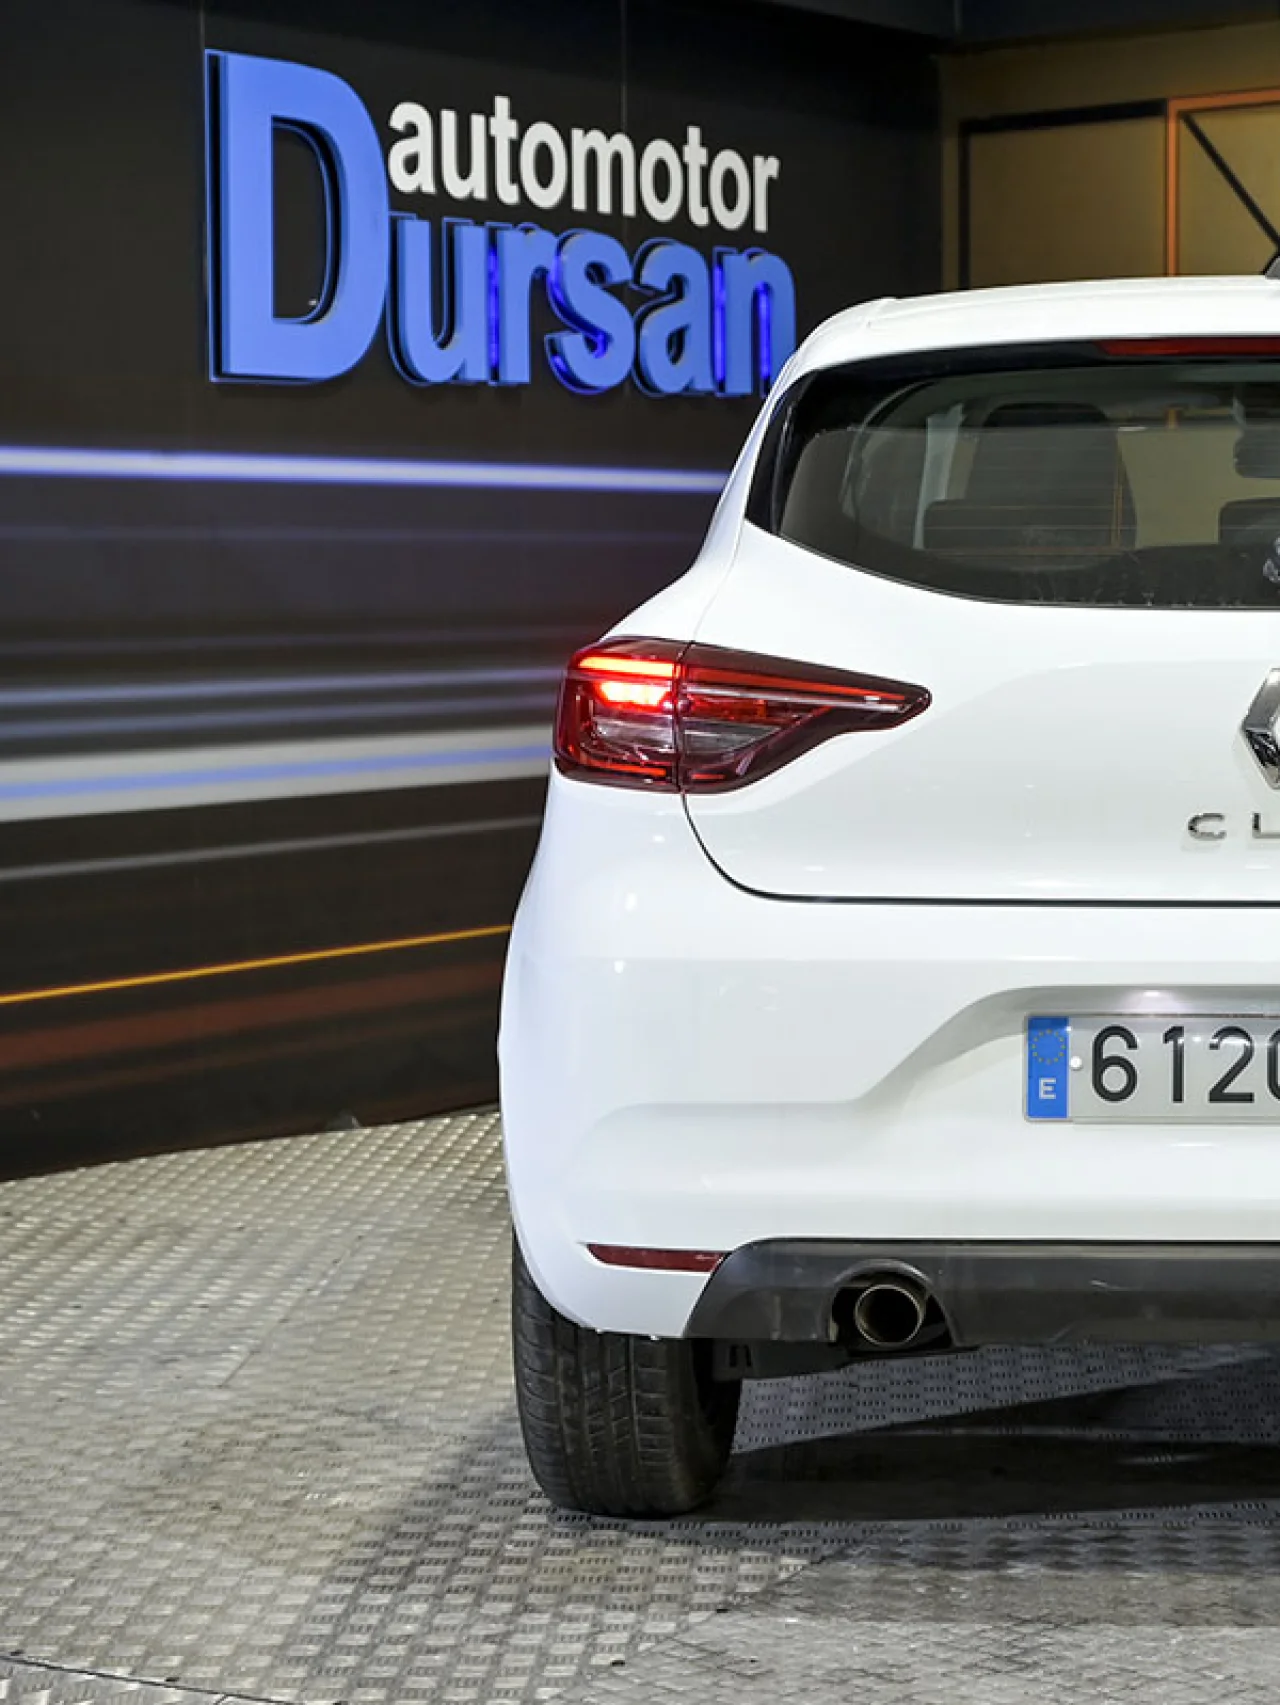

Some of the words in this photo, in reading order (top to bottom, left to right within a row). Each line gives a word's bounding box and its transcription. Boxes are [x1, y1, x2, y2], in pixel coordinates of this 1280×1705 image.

[205, 49, 796, 397] Dursan
[389, 95, 780, 232] automotor
[1039, 1077, 1056, 1100] E
